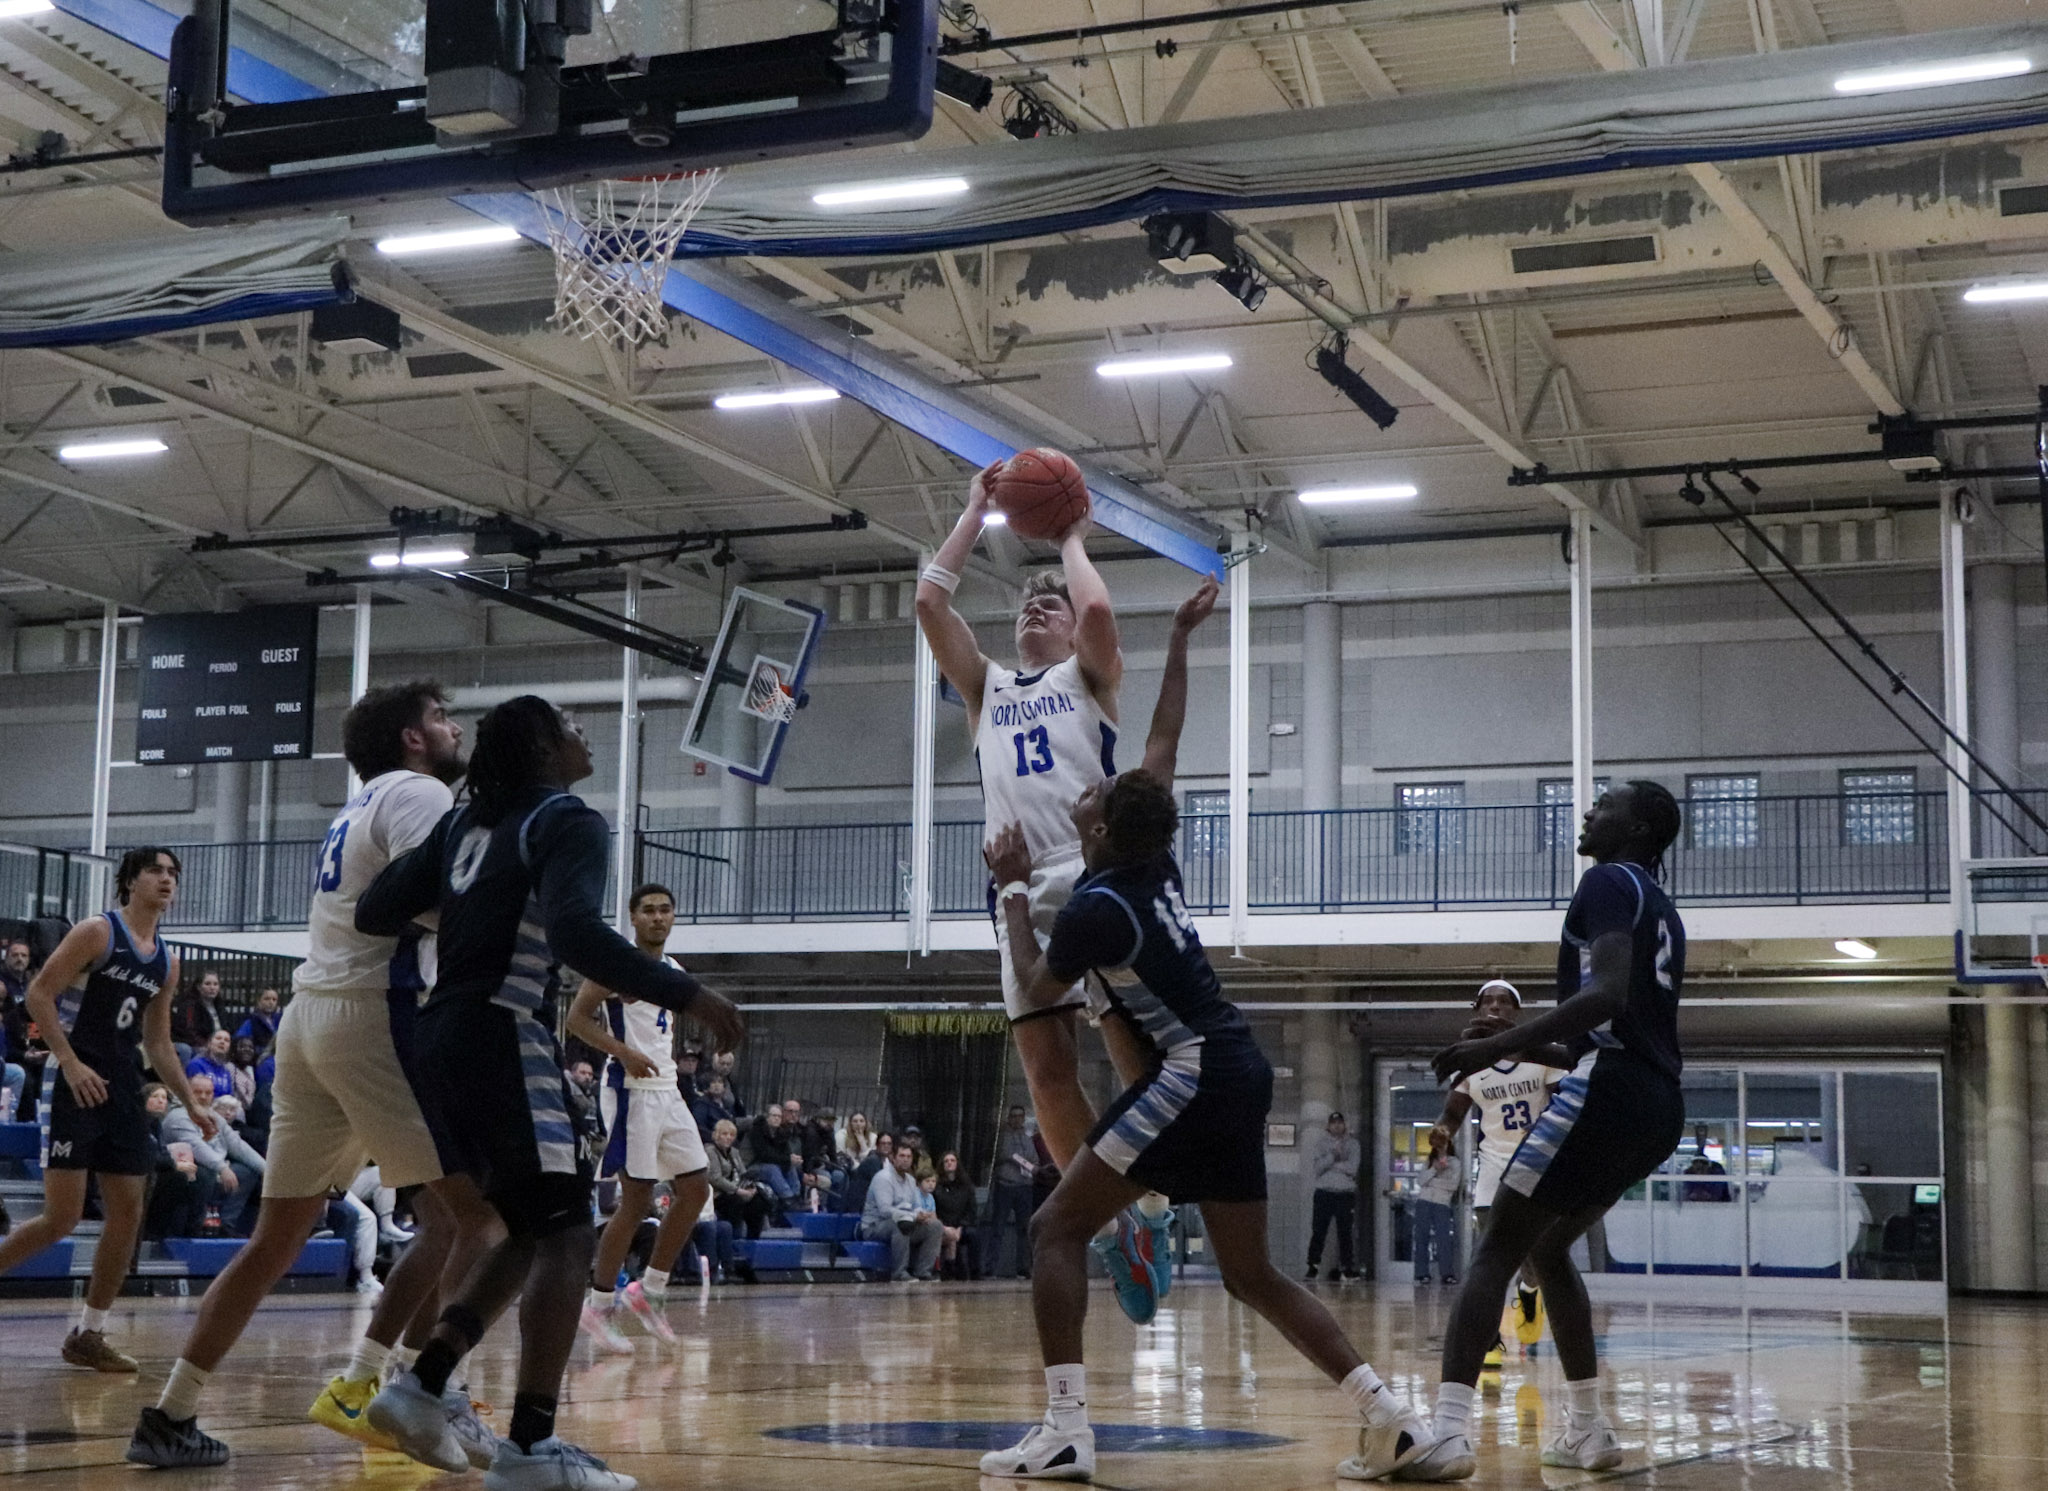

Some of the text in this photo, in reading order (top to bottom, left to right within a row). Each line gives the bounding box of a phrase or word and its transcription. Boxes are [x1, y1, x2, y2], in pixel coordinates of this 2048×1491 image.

[152, 654, 186, 670] HOME
[261, 648, 300, 664] GUEST
[209, 662, 238, 673] PERIOD
[142, 709, 167, 719] FOULS
[195, 705, 249, 717] PLAYER FOUL
[275, 702, 302, 713] FOULS
[1021, 693, 1075, 720] CENTRAL
[139, 750, 165, 761] SCORE
[206, 747, 233, 757] MATCH
[273, 743, 300, 755] SCORE
[1014, 724, 1055, 777] 13
[450, 826, 492, 894] 0
[1655, 918, 1673, 991] 2
[101, 964, 161, 998] Mid Michig
[116, 996, 138, 1030] 6
[656, 1007, 668, 1034] 4
[1481, 1085, 1507, 1100] NORTH
[1501, 1100, 1532, 1130] 23
